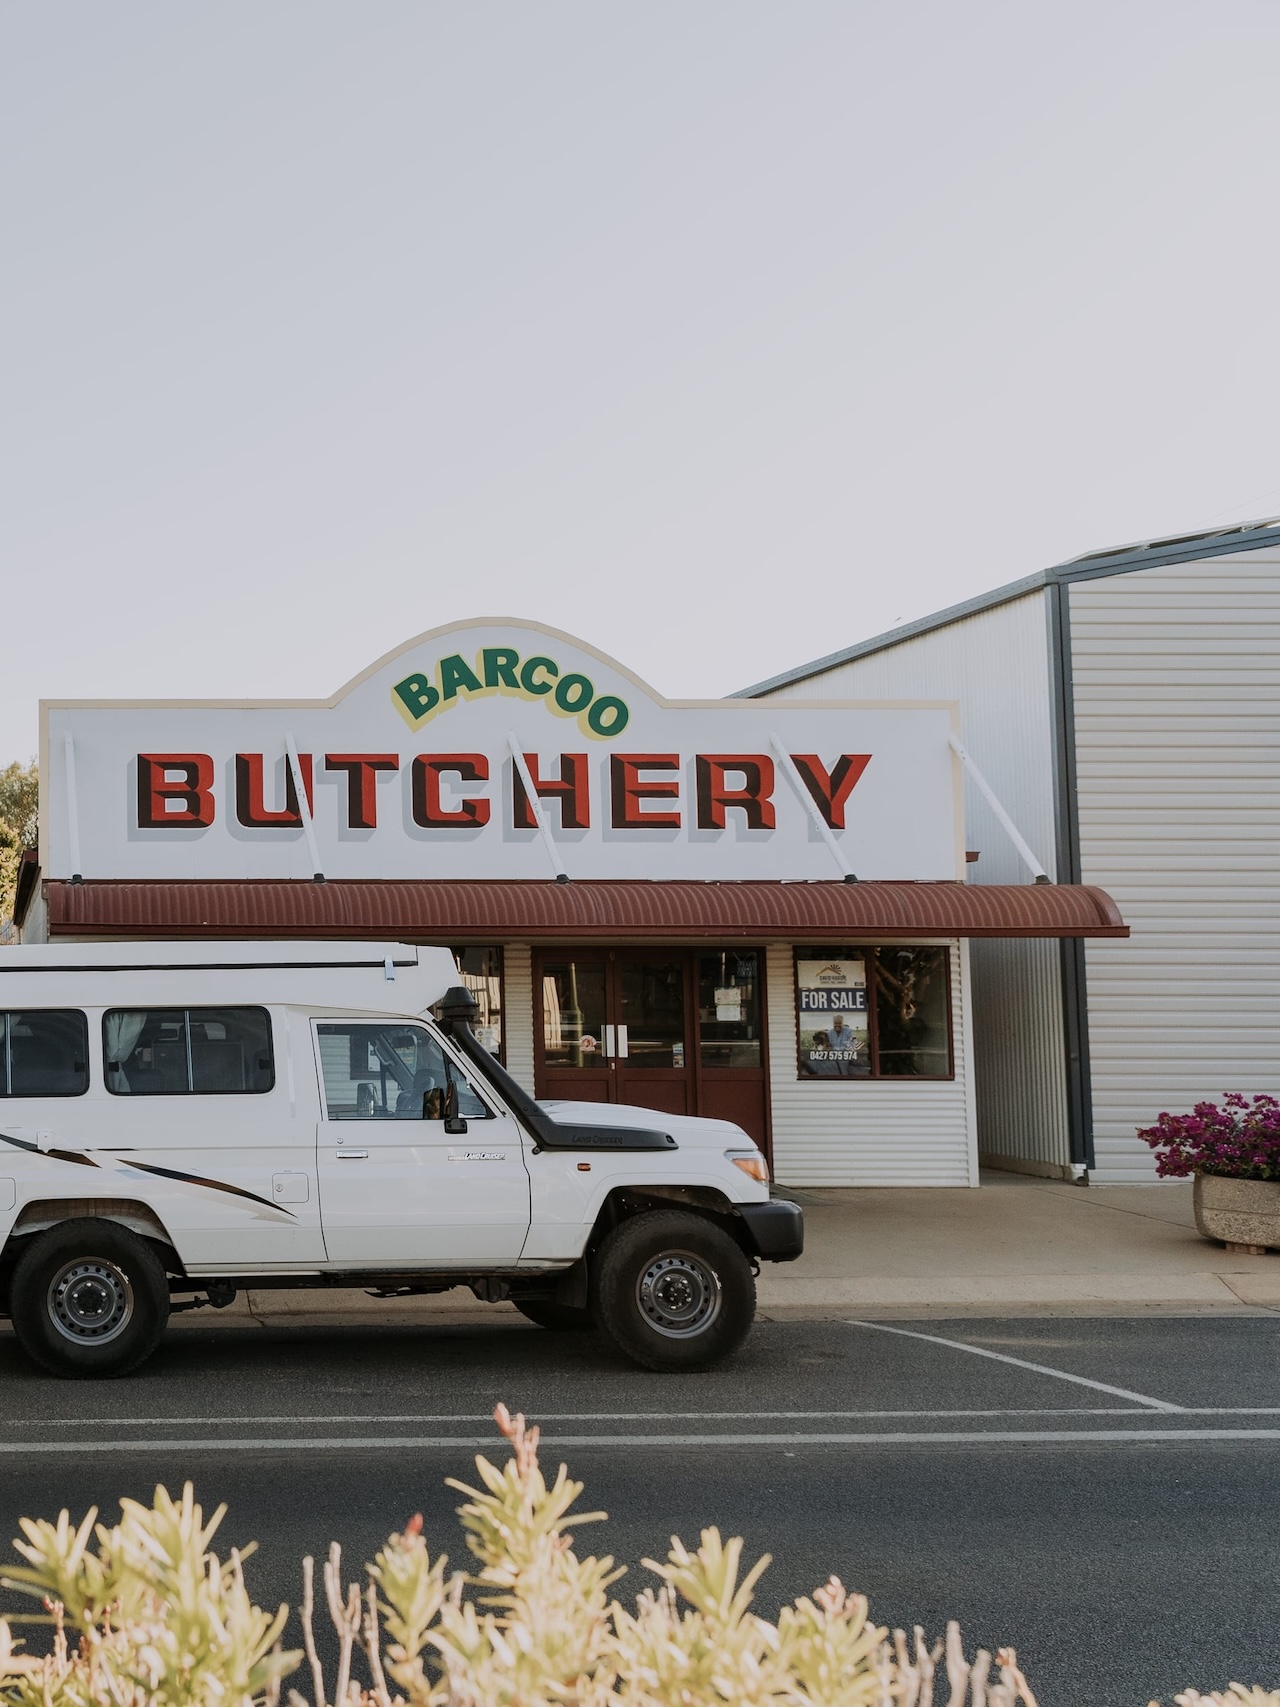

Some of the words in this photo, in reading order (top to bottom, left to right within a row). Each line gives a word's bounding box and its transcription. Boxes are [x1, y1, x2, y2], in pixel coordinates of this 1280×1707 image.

[390, 646, 631, 740] BARCOO
[136, 752, 873, 830] BUTCHERY
[802, 991, 827, 1008] FOR
[831, 991, 865, 1008] SALE
[810, 1051, 827, 1060] 0427
[829, 1051, 843, 1060] 575
[844, 1051, 857, 1060] 974
[571, 1135, 591, 1143] LAND
[593, 1135, 623, 1144] CRUISER
